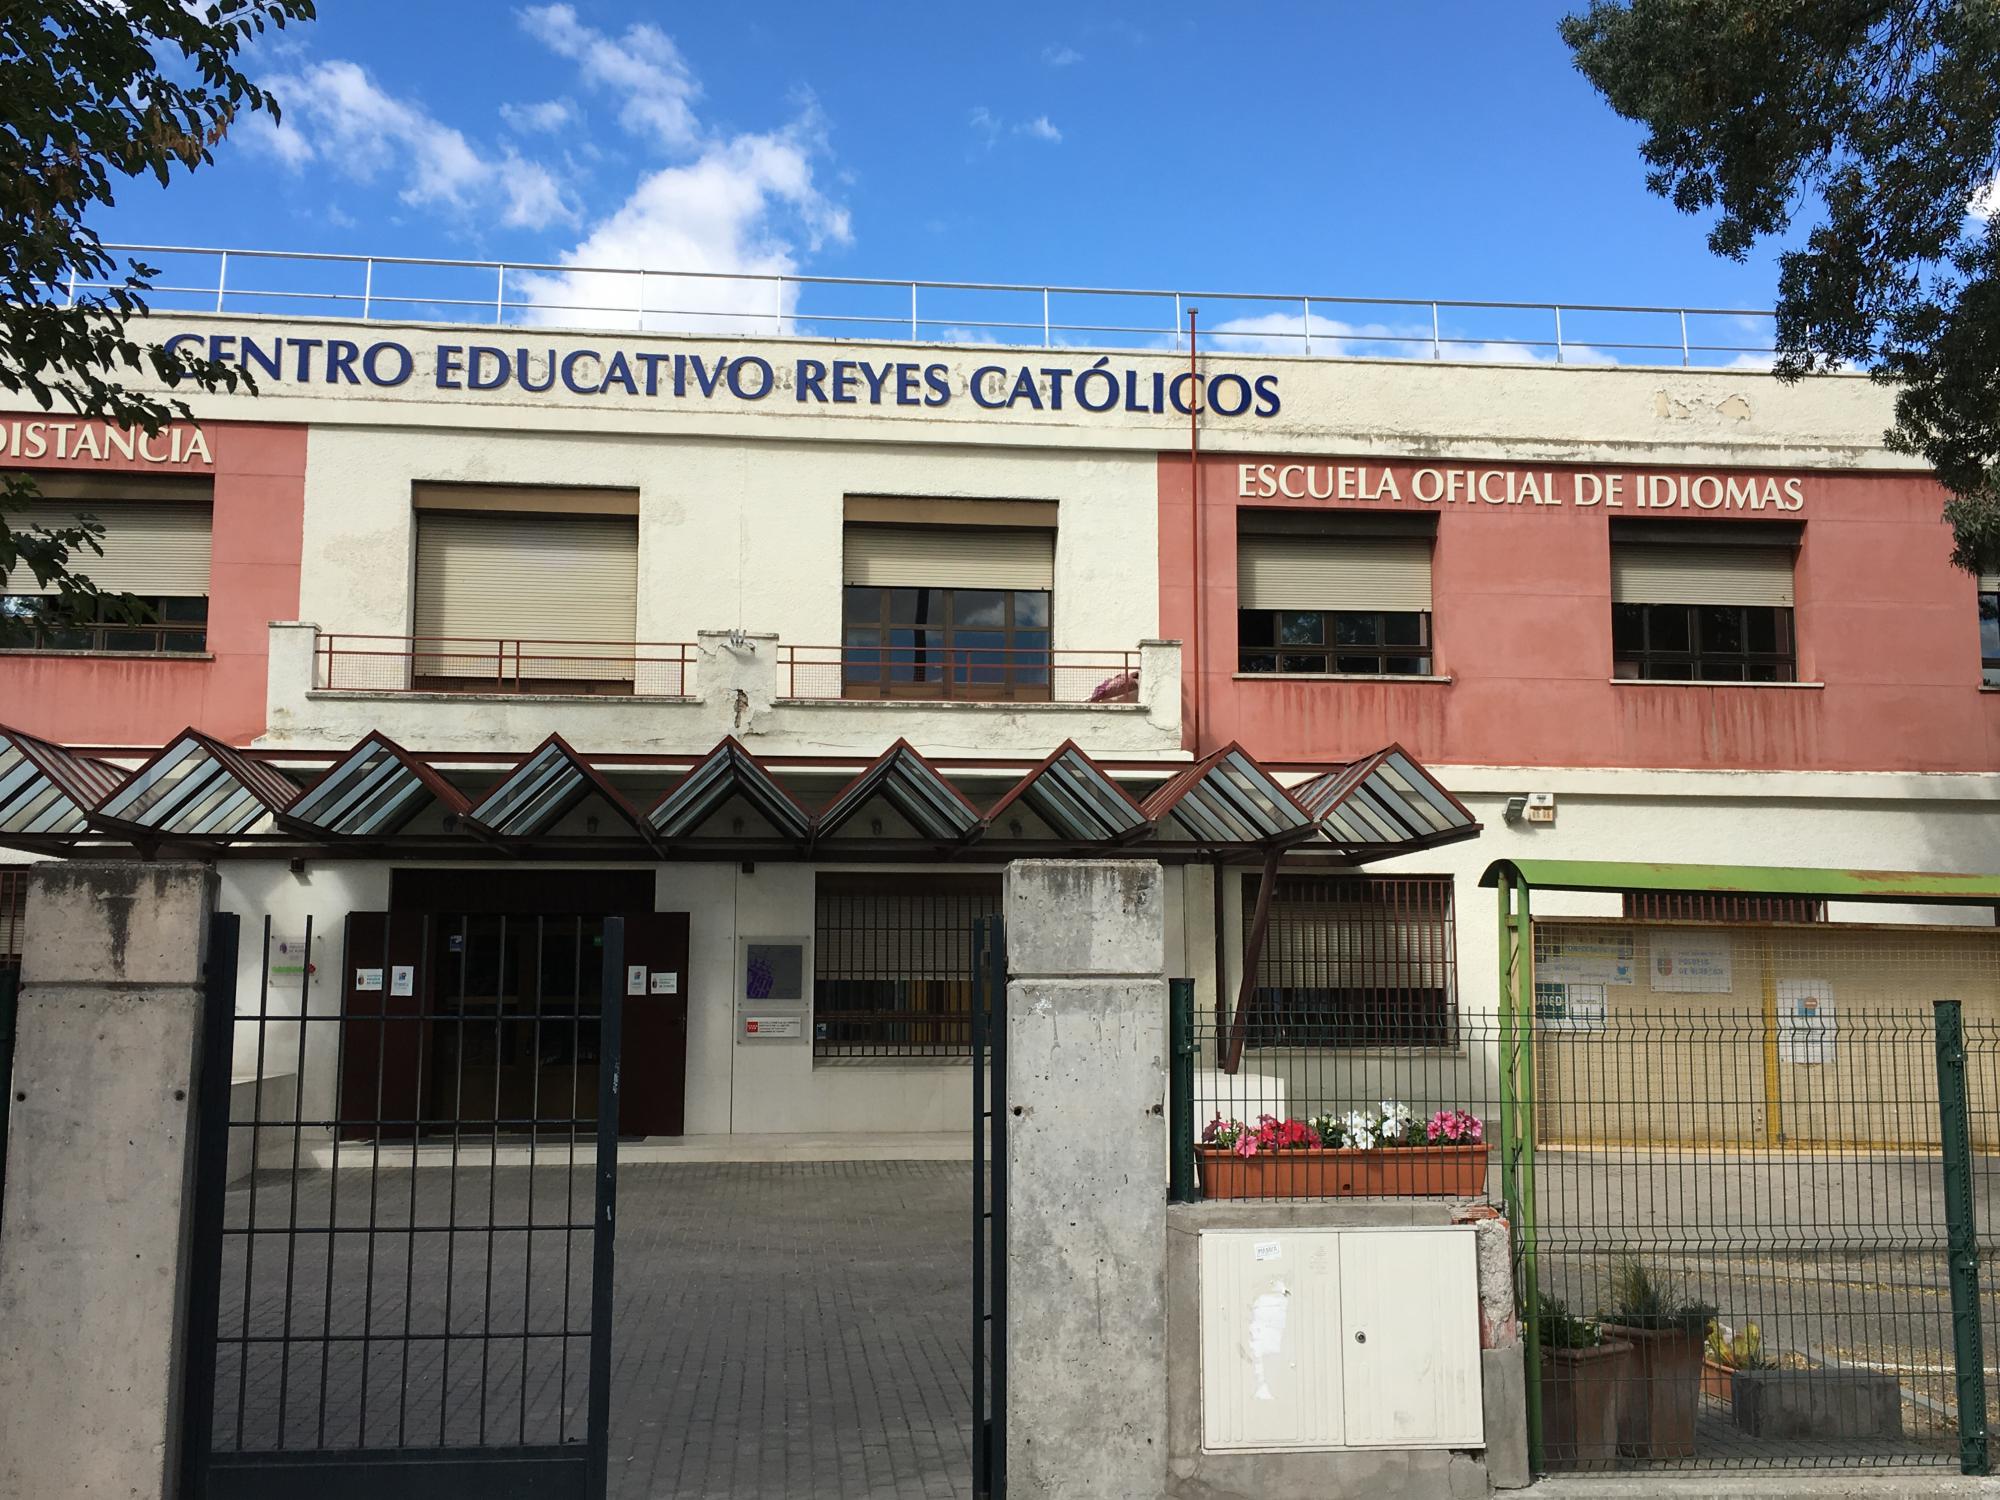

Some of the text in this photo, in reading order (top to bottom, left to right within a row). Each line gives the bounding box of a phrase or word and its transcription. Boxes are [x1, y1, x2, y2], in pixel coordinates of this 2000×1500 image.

[164, 333, 1281, 418] CENTRO EDUCATIVO REYES CATÓLICOS
[1238, 463, 1804, 511] ESCUELA OFICIAL DE IDIOMAS
